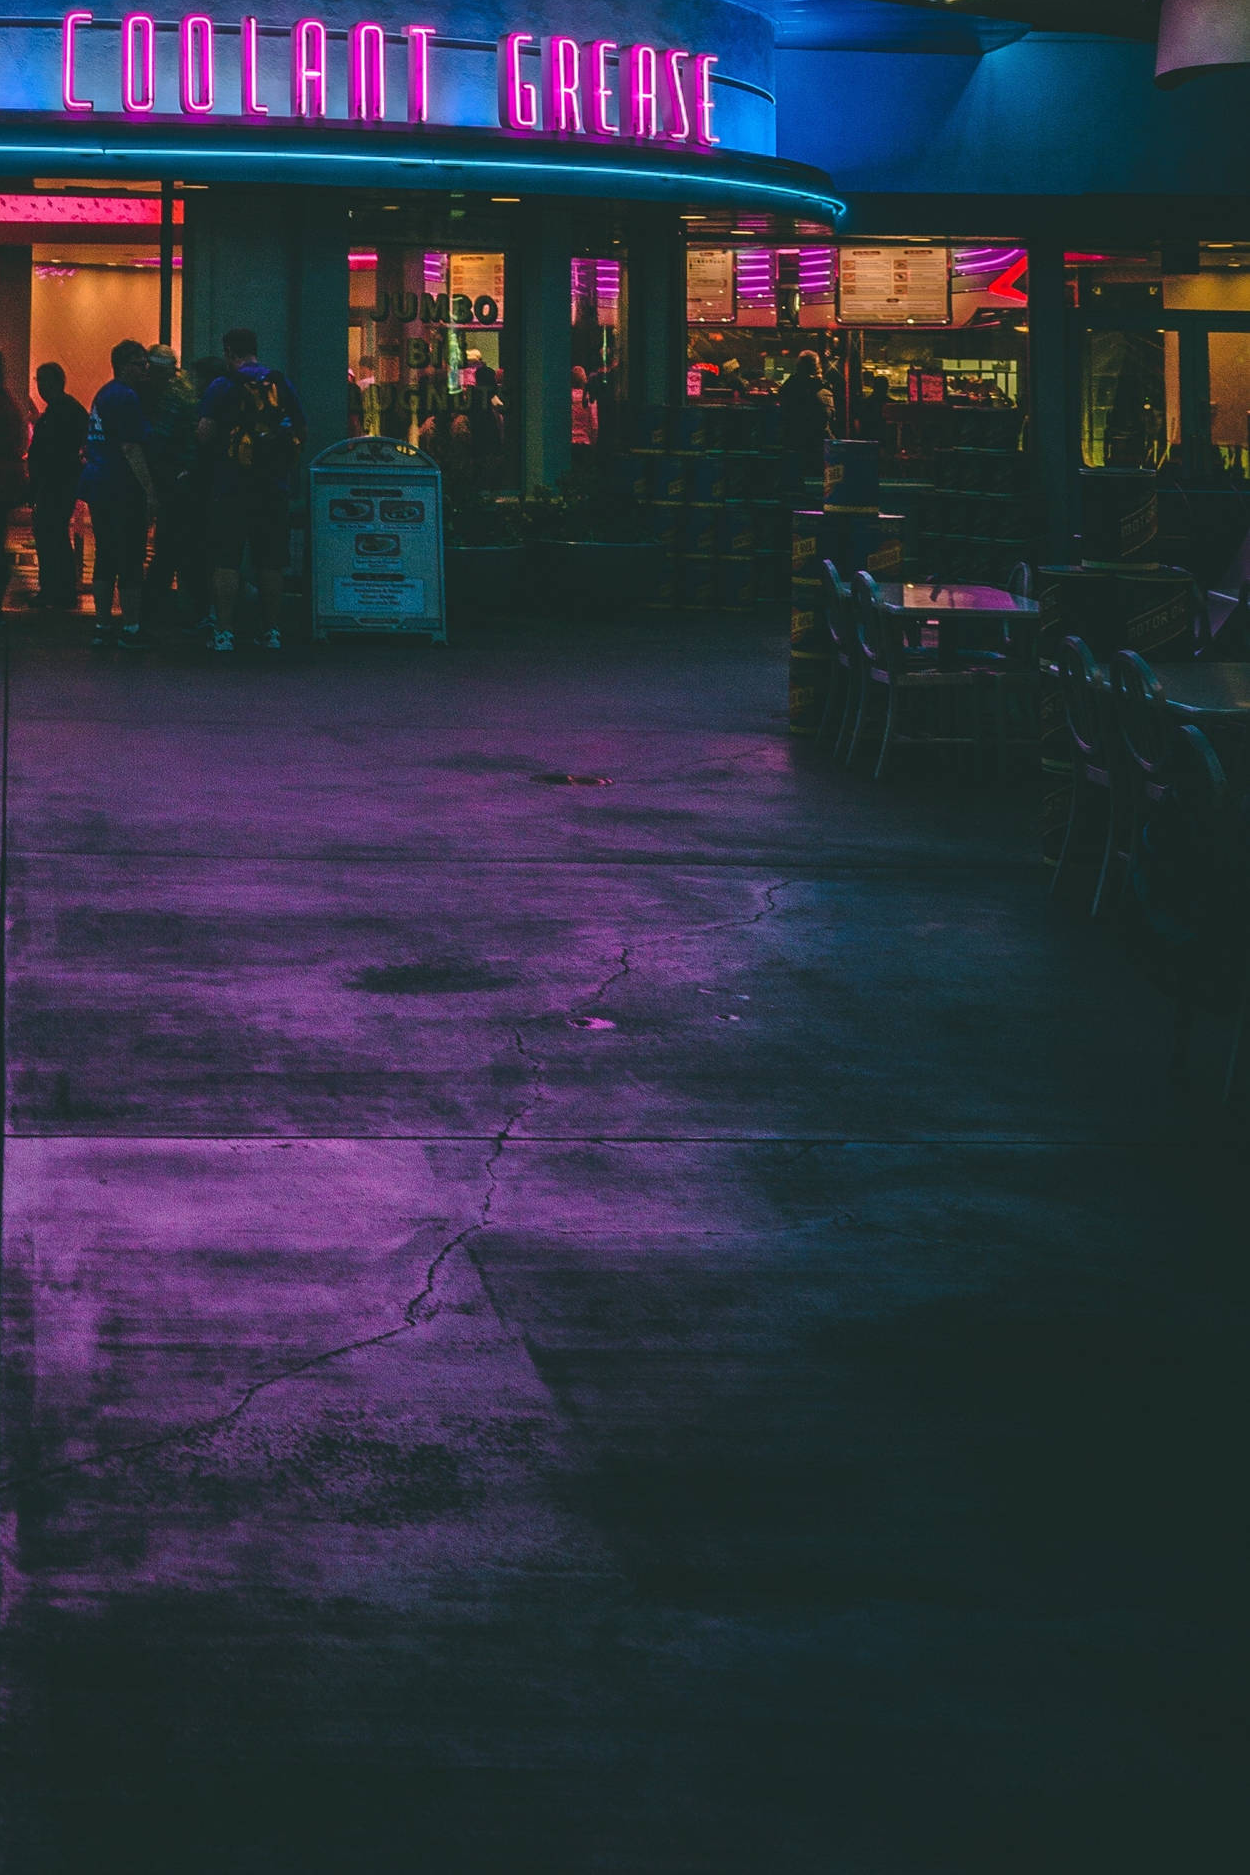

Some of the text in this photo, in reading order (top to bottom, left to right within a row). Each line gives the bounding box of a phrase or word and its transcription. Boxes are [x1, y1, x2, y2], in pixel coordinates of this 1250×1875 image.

[62, 11, 437, 122] COOLANT
[500, 30, 722, 146] GREASE
[370, 292, 498, 324] JUMBO
